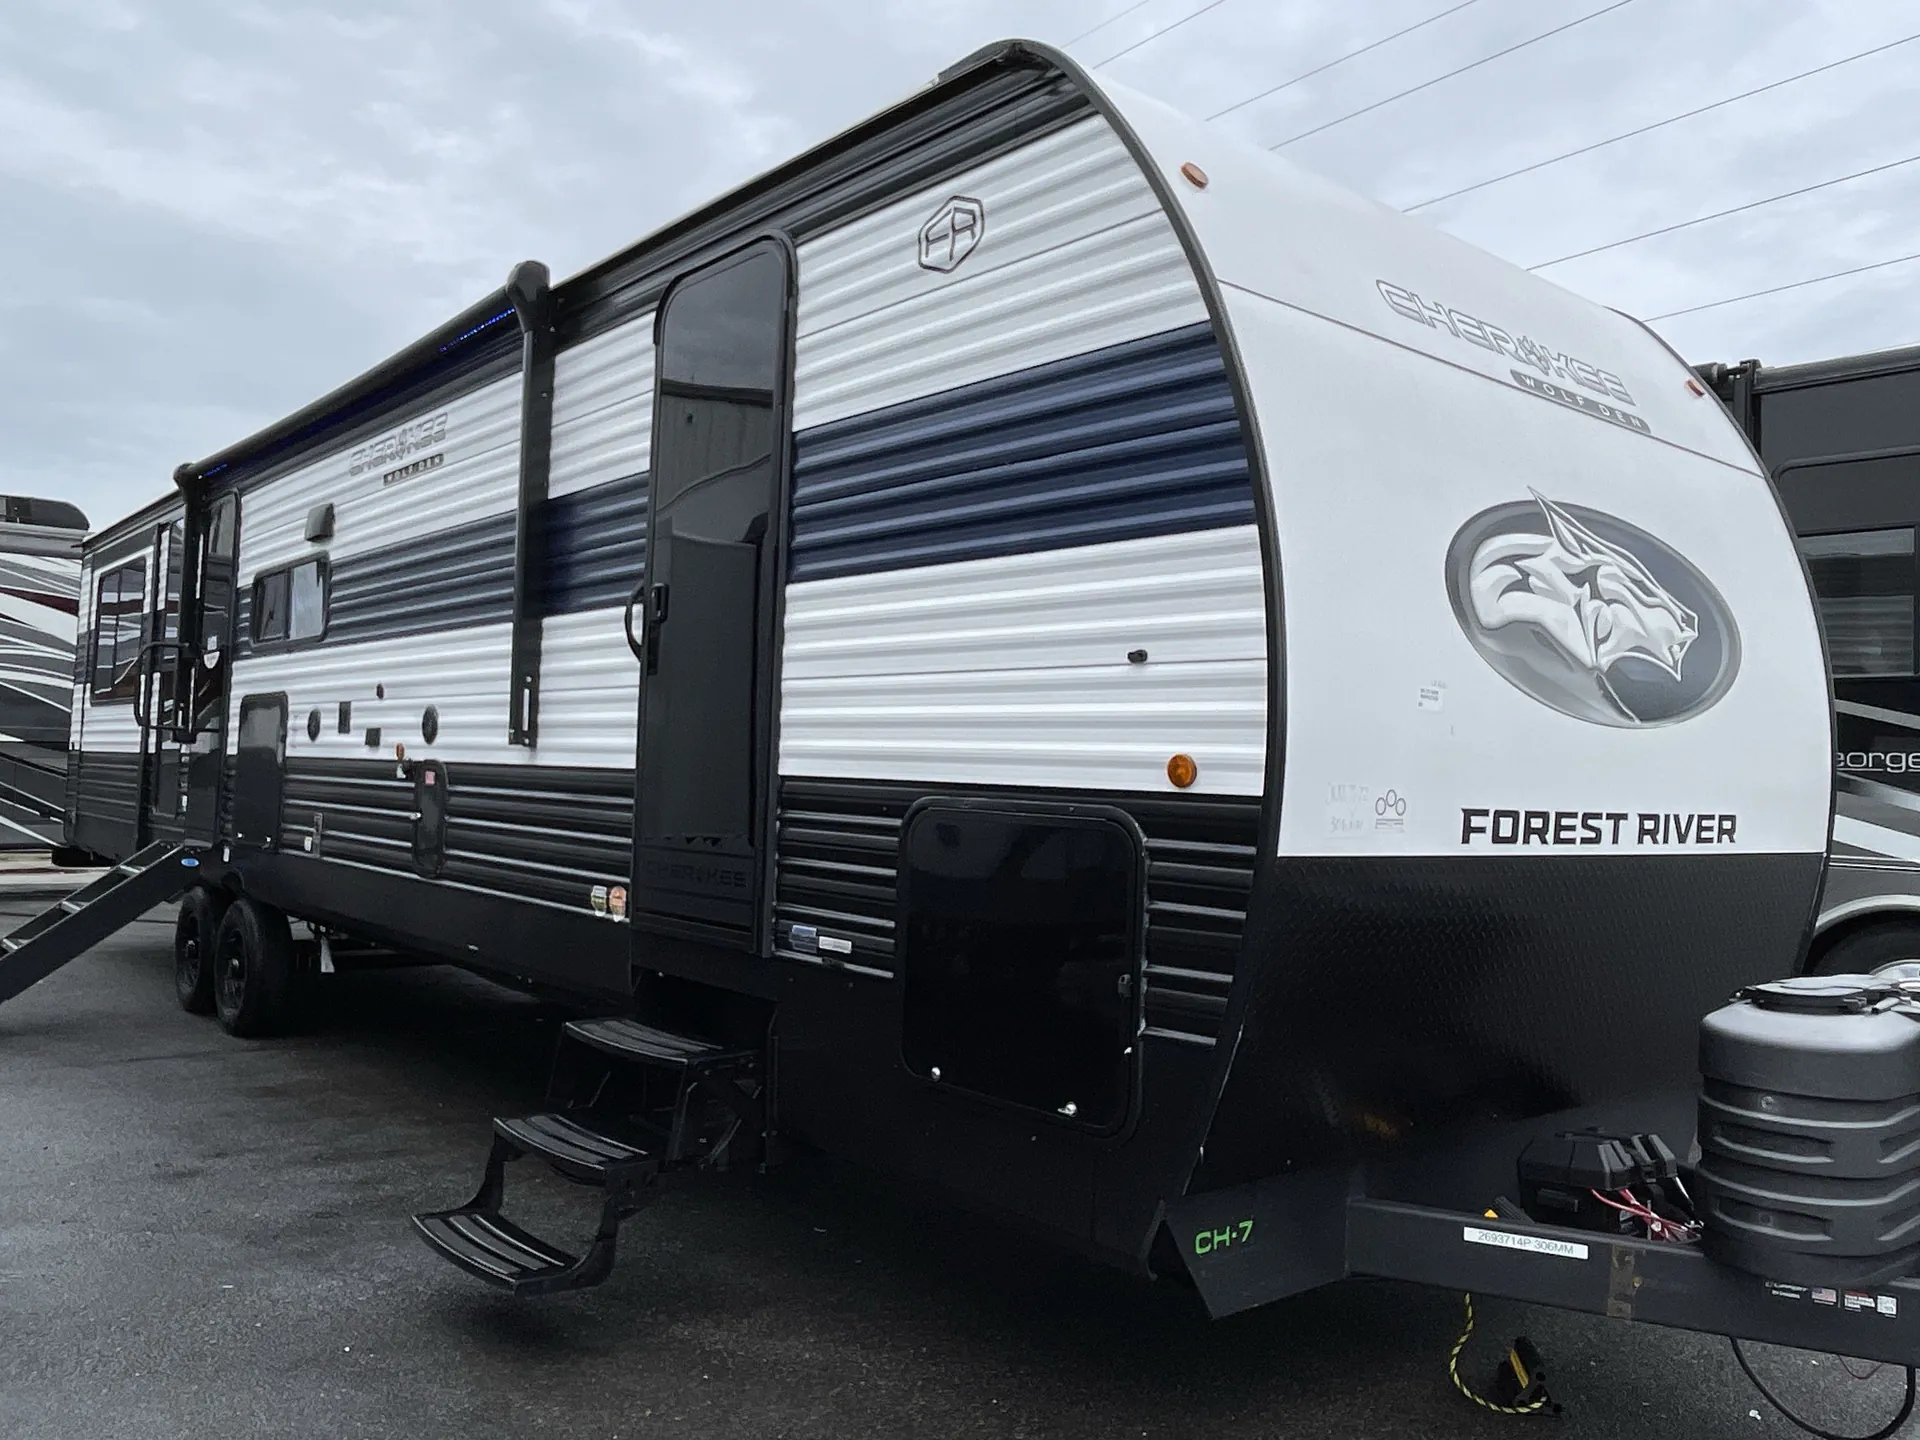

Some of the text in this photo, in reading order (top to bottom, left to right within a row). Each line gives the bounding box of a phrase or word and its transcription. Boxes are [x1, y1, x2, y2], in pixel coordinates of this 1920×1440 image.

[1521, 374, 1642, 429] WOLF DEN
[1461, 808, 1737, 845] FOREST RIVER
[1478, 1230, 1574, 1255] 2693714P 306MM
